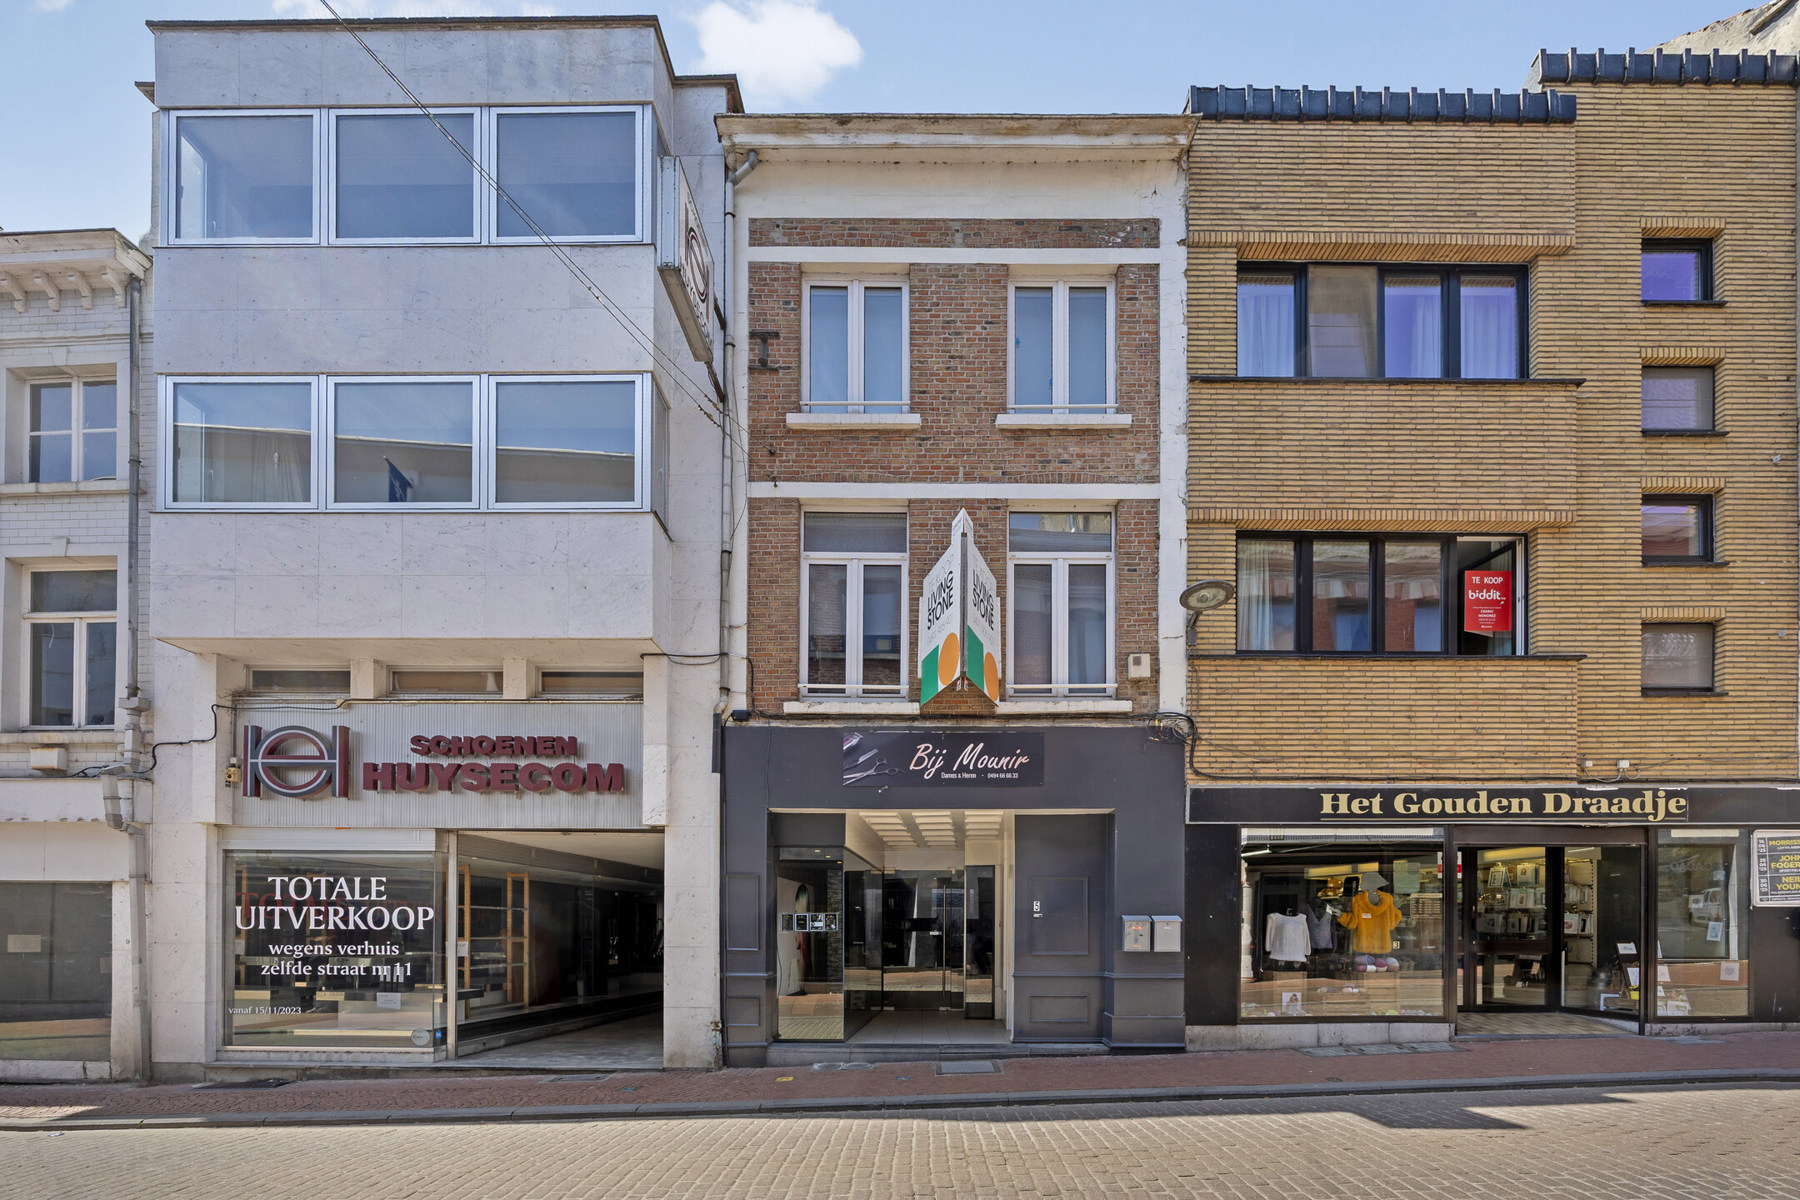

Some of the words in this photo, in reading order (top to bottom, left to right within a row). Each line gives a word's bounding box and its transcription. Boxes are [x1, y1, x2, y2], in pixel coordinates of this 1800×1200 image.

[928, 570, 954, 611] LIVING
[973, 568, 994, 611] LIVING
[1472, 576, 1480, 584] TE
[1484, 576, 1504, 584] KOOP
[927, 586, 954, 631] STONE
[972, 586, 995, 631] STONE
[410, 734, 578, 757] SCHOENEN
[909, 742, 947, 780] Bij
[953, 742, 1030, 771] Mounir
[362, 761, 625, 793] HUYSECOM
[1320, 792, 1384, 814] Het
[1393, 790, 1533, 814] Gouden
[1542, 790, 1687, 822] Draadje
[267, 876, 387, 901] TOTALE
[235, 906, 435, 931] UITVERKOOP
[1034, 901, 1040, 911] 5
[268, 943, 333, 959] wegens
[337, 941, 400, 956] verhuis
[1393, 941, 1400, 949] 3
[261, 961, 313, 976] zelfde
[317, 963, 367, 976] straat
[372, 964, 388, 976] nr
[395, 962, 411, 976] 11
[228, 1005, 252, 1015] vanaf
[254, 1005, 302, 1016] 15/11/2023
